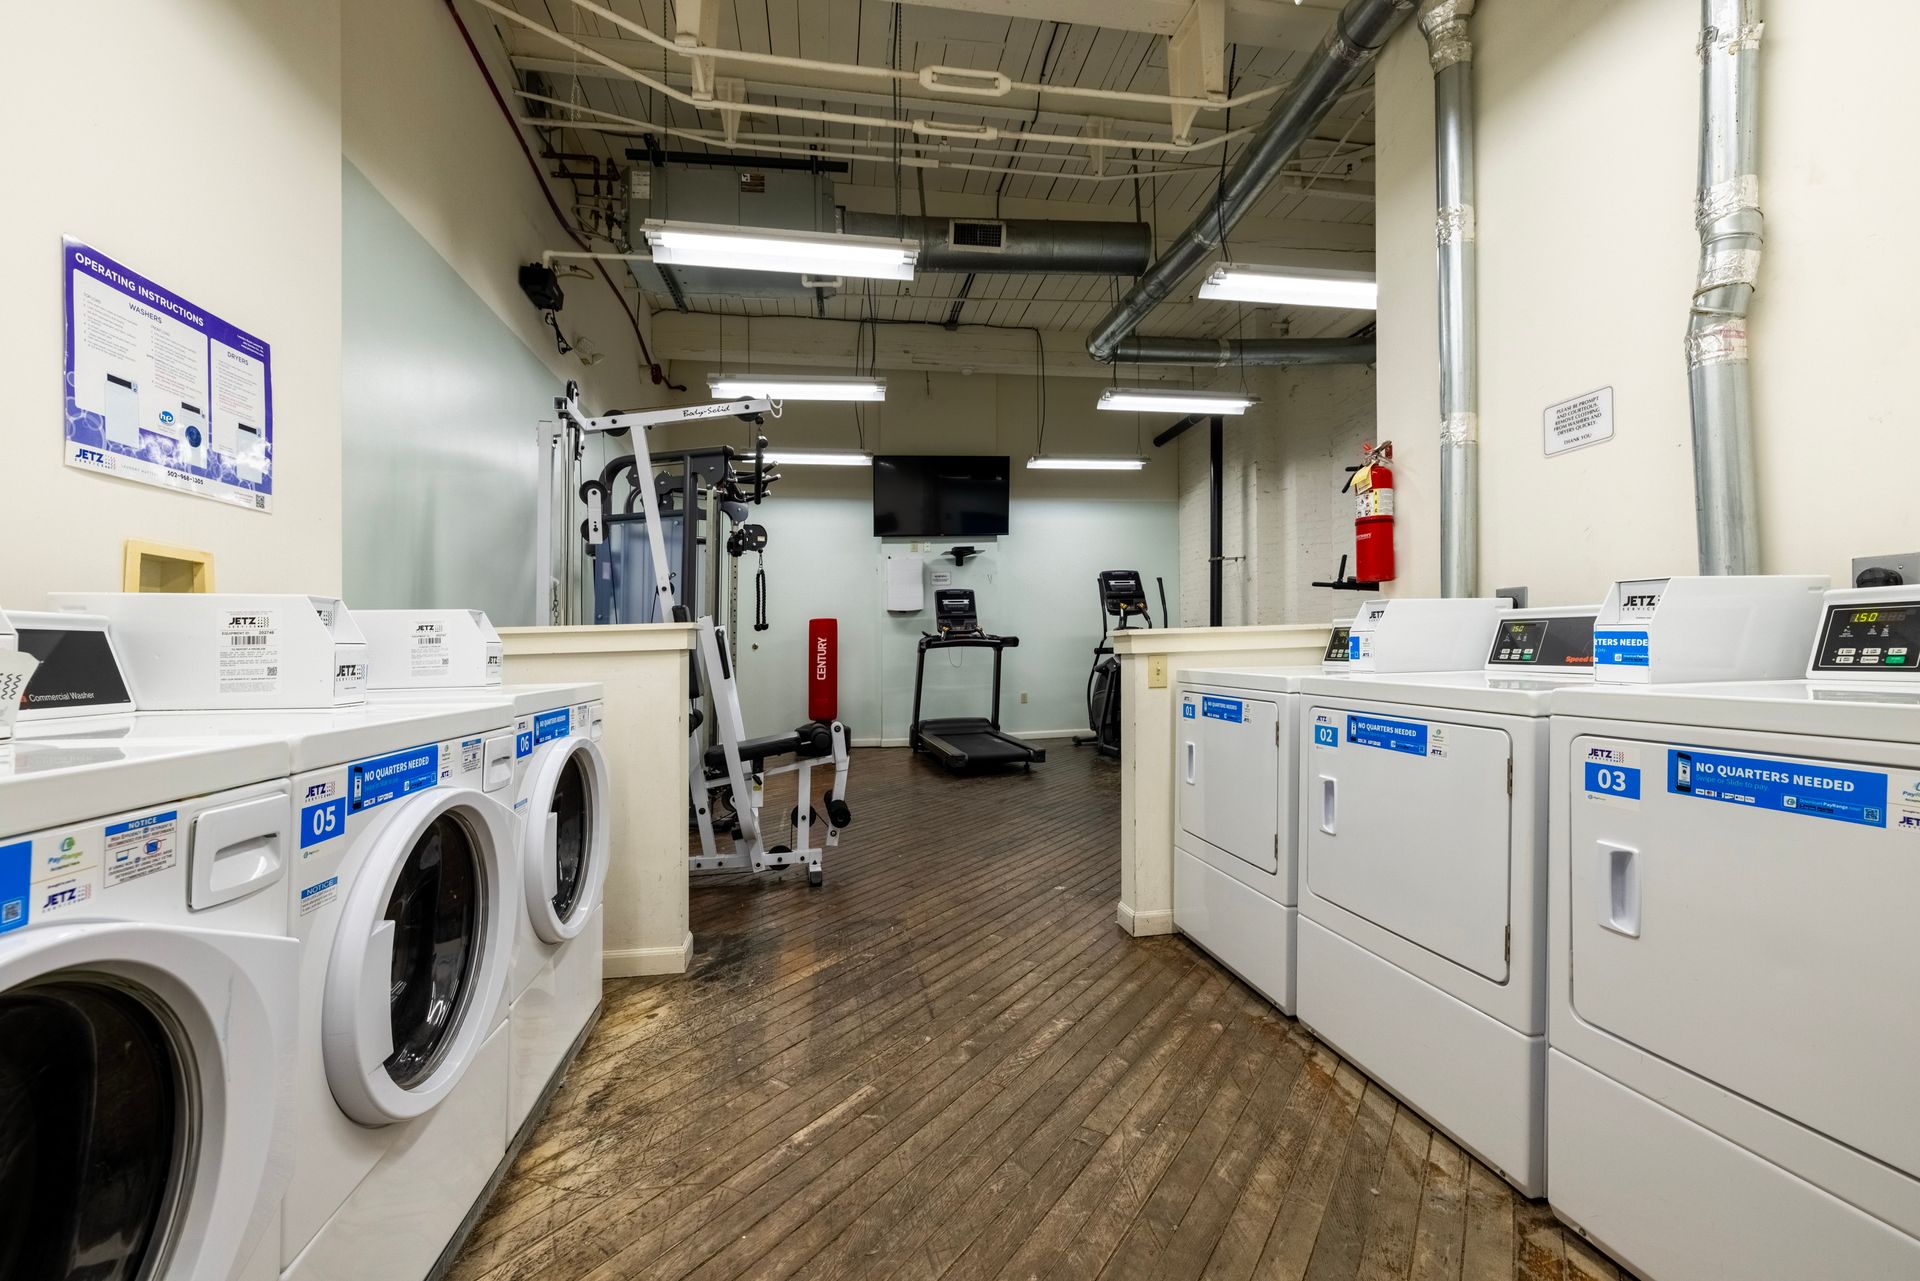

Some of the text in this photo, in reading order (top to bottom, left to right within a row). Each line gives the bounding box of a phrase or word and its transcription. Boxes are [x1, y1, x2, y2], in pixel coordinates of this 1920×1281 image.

[75, 252, 204, 326] OPERATING INSTRUCTIONS
[129, 302, 162, 324] WASHERS
[227, 352, 248, 366] DRYERS
[683, 405, 730, 418] Body-Solid
[75, 448, 104, 463] JETZ
[1623, 595, 1655, 606] JETZ
[229, 617, 256, 625] JETZ
[488, 656, 498, 664] JETZ
[817, 637, 827, 680] CENTURY
[336, 665, 356, 677] JETZ
[29, 692, 69, 702] Commercial
[1186, 706, 1192, 716] 01
[1320, 728, 1332, 742] 02
[1366, 724, 1393, 734] QUARTERS
[1394, 728, 1416, 736] NEEDED
[520, 736, 529, 752] 06
[1588, 748, 1612, 758] JETZ
[365, 756, 429, 782] NO QUARTERS NEEDED
[1598, 769, 1626, 791] 03
[1696, 762, 1854, 792] NO QUARTERS NEEDED
[305, 783, 327, 798] JETZ
[1823, 802, 1848, 810] PayRange
[128, 817, 157, 829] NOTICE
[313, 805, 336, 835] 05
[48, 851, 83, 864] PayRange
[306, 880, 334, 896] NOTICE
[43, 888, 77, 908] JETZ
